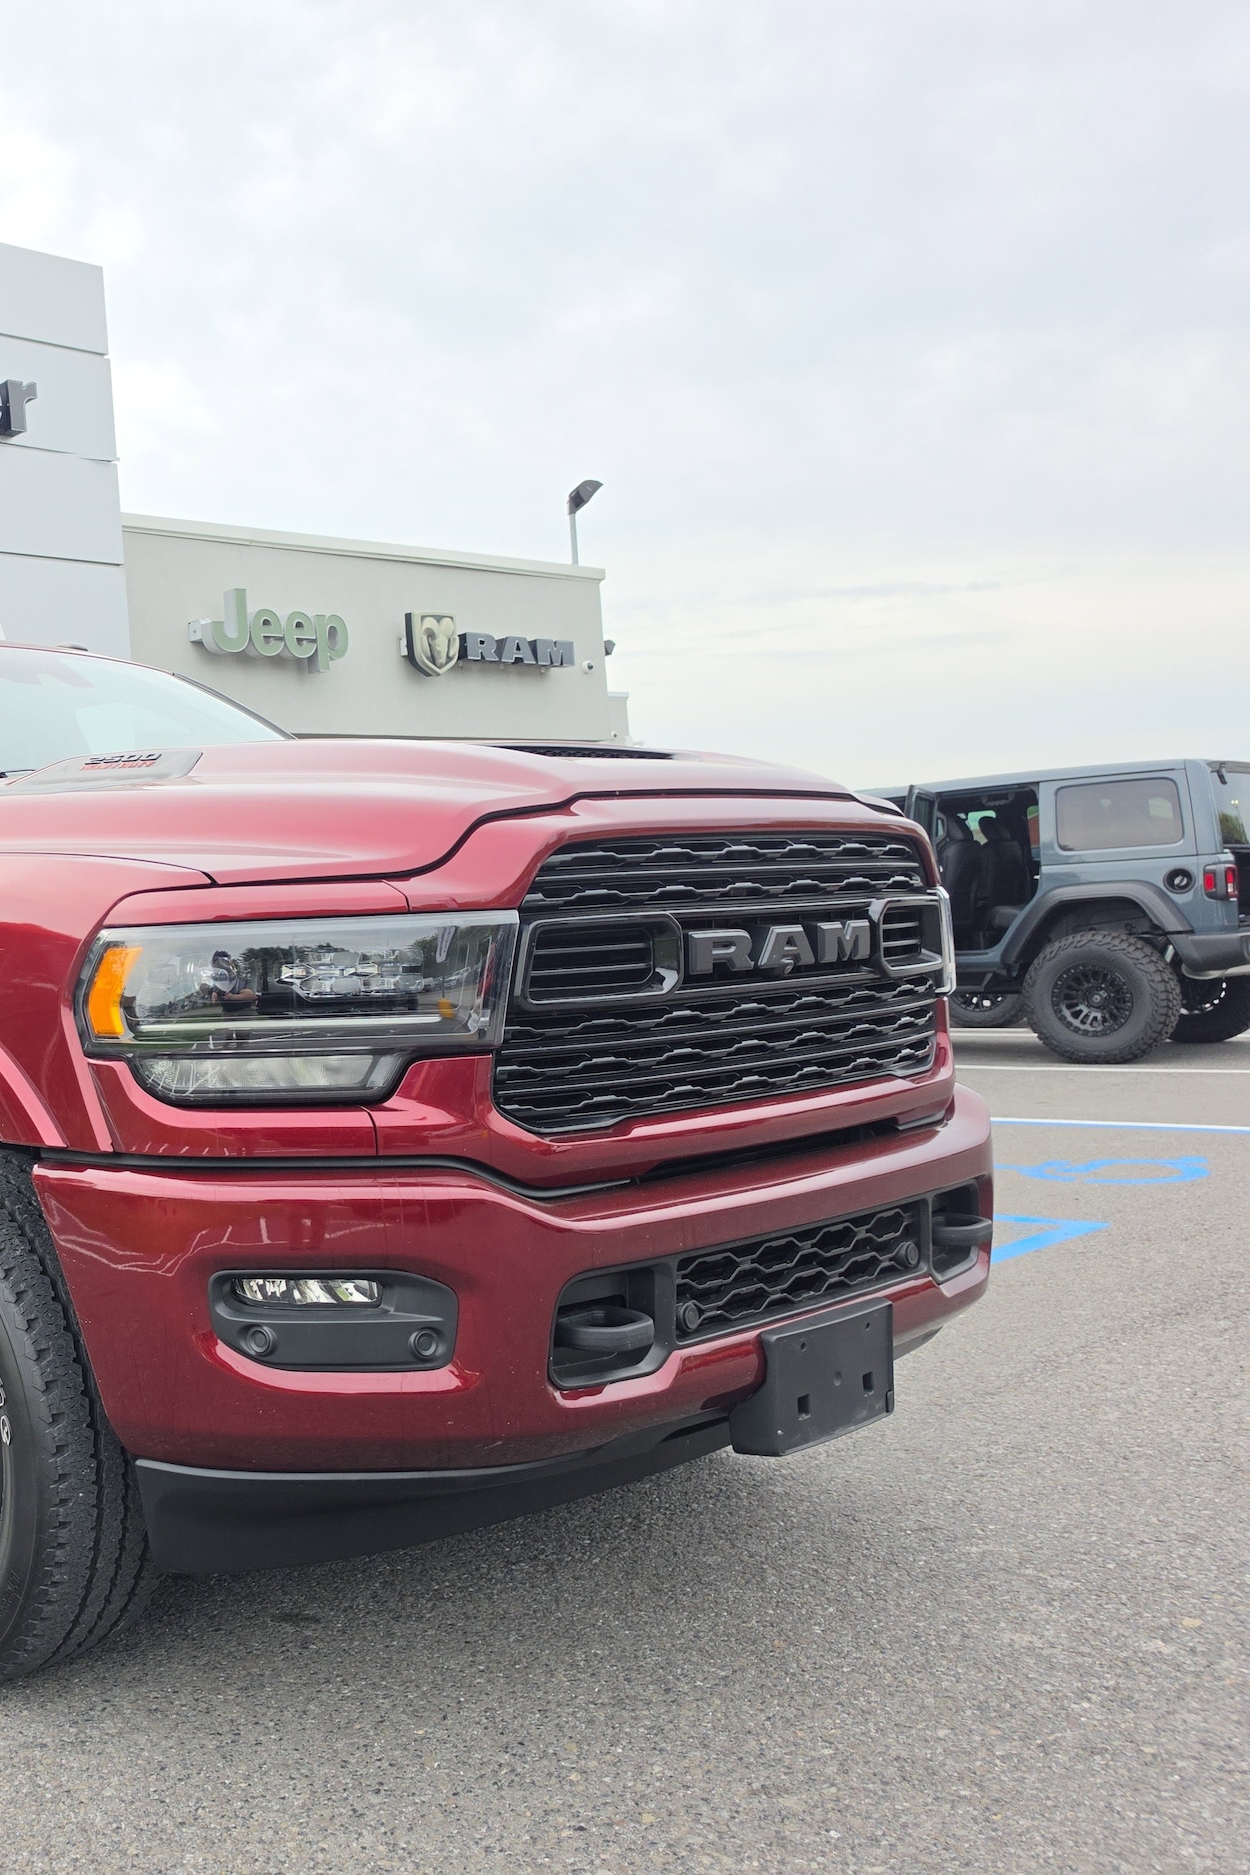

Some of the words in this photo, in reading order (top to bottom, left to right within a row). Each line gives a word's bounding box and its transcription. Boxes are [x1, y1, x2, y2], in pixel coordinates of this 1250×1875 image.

[201, 588, 349, 673] Jeep
[460, 632, 575, 668] RAM
[689, 919, 871, 974] RAM
